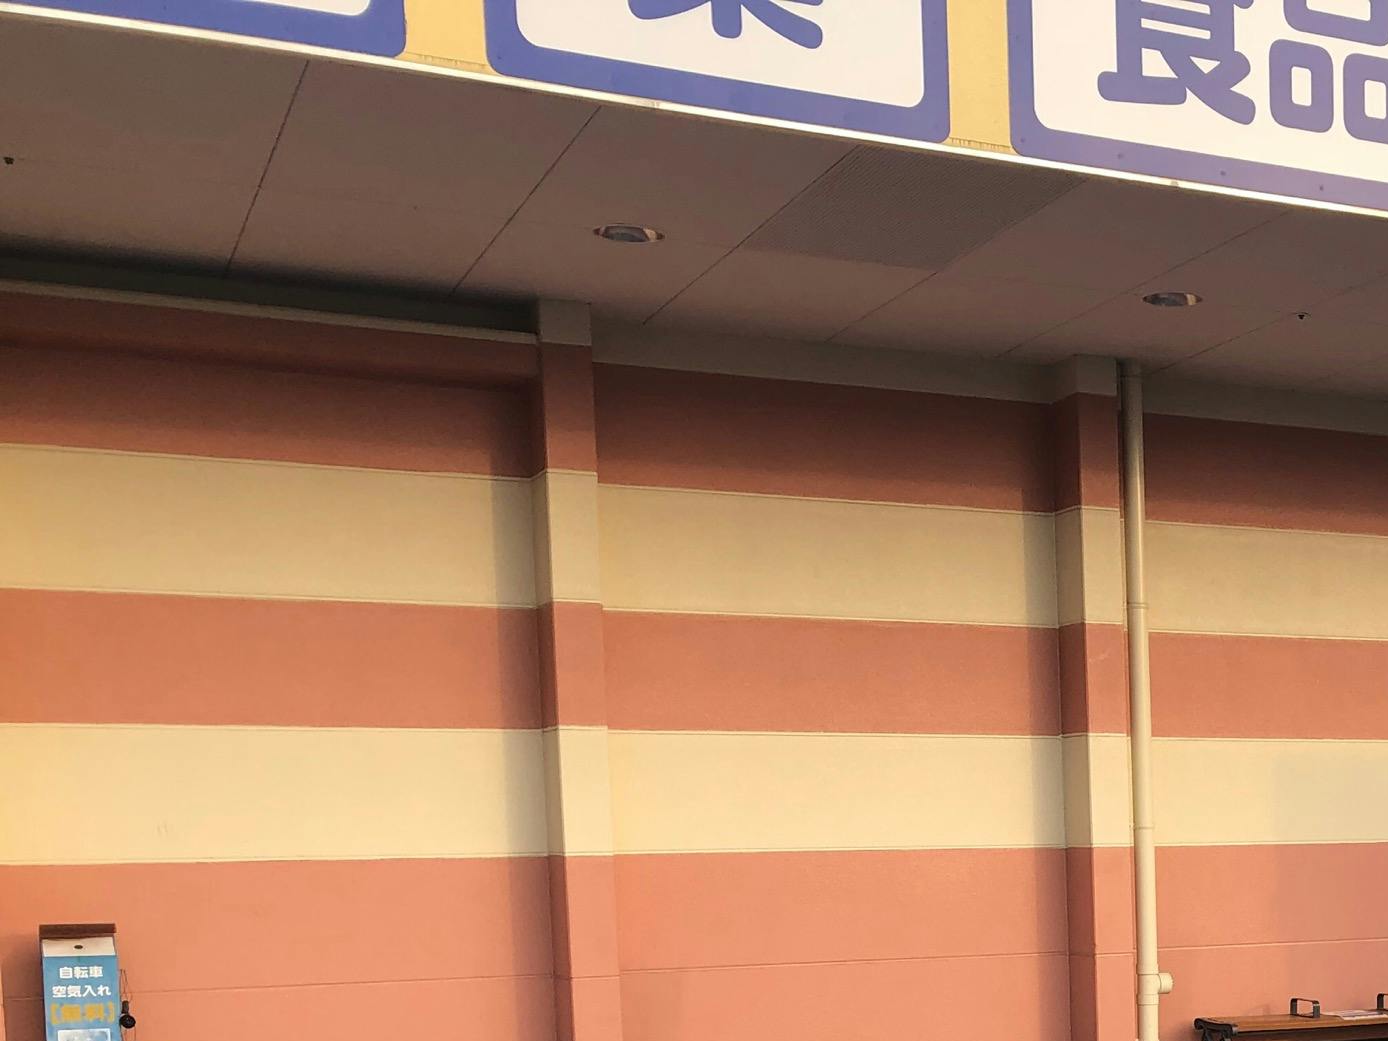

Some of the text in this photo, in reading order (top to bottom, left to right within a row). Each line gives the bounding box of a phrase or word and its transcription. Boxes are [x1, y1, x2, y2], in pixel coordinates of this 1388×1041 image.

[59, 966, 103, 979] 自転車
[52, 985, 111, 997] 空気入れ
